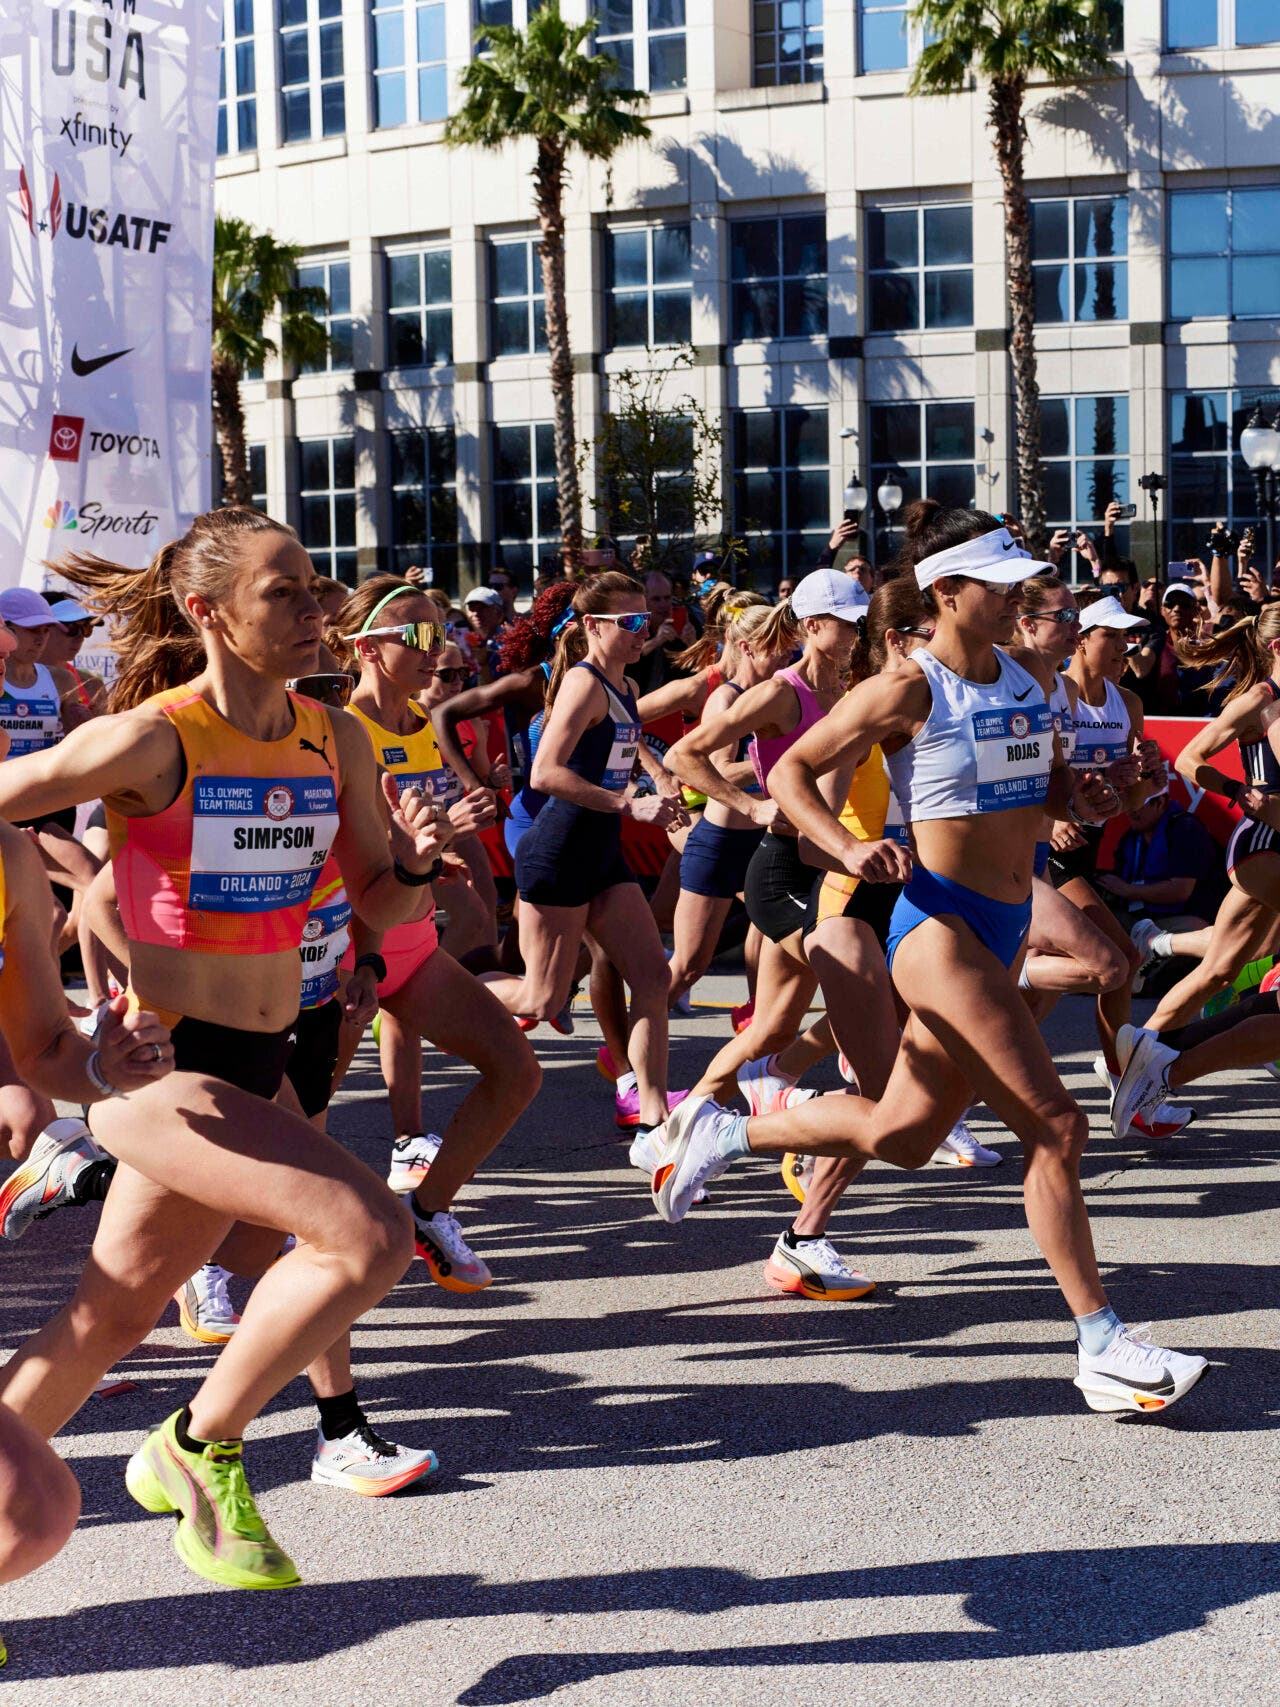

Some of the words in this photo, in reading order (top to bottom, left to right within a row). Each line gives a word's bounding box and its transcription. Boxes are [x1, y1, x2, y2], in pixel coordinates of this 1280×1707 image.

[51, 8, 147, 101] USA
[60, 112, 133, 157] xfinity
[65, 202, 172, 254] USATF
[90, 431, 161, 459] TOYOTA
[78, 501, 159, 540] Sports
[1072, 721, 1124, 730] SALOMON
[1006, 741, 1040, 762] ROJAS
[199, 788, 217, 798] U.S.
[217, 788, 253, 799] OLYMPIC
[303, 788, 333, 800] MARATHON
[994, 779, 1028, 795] ORLANDO
[199, 799, 223, 810] TEAM
[224, 799, 254, 811] TRIALS
[233, 826, 315, 850] SIMPSON
[219, 875, 282, 892] ORLANDO
[290, 872, 312, 888] 2024
